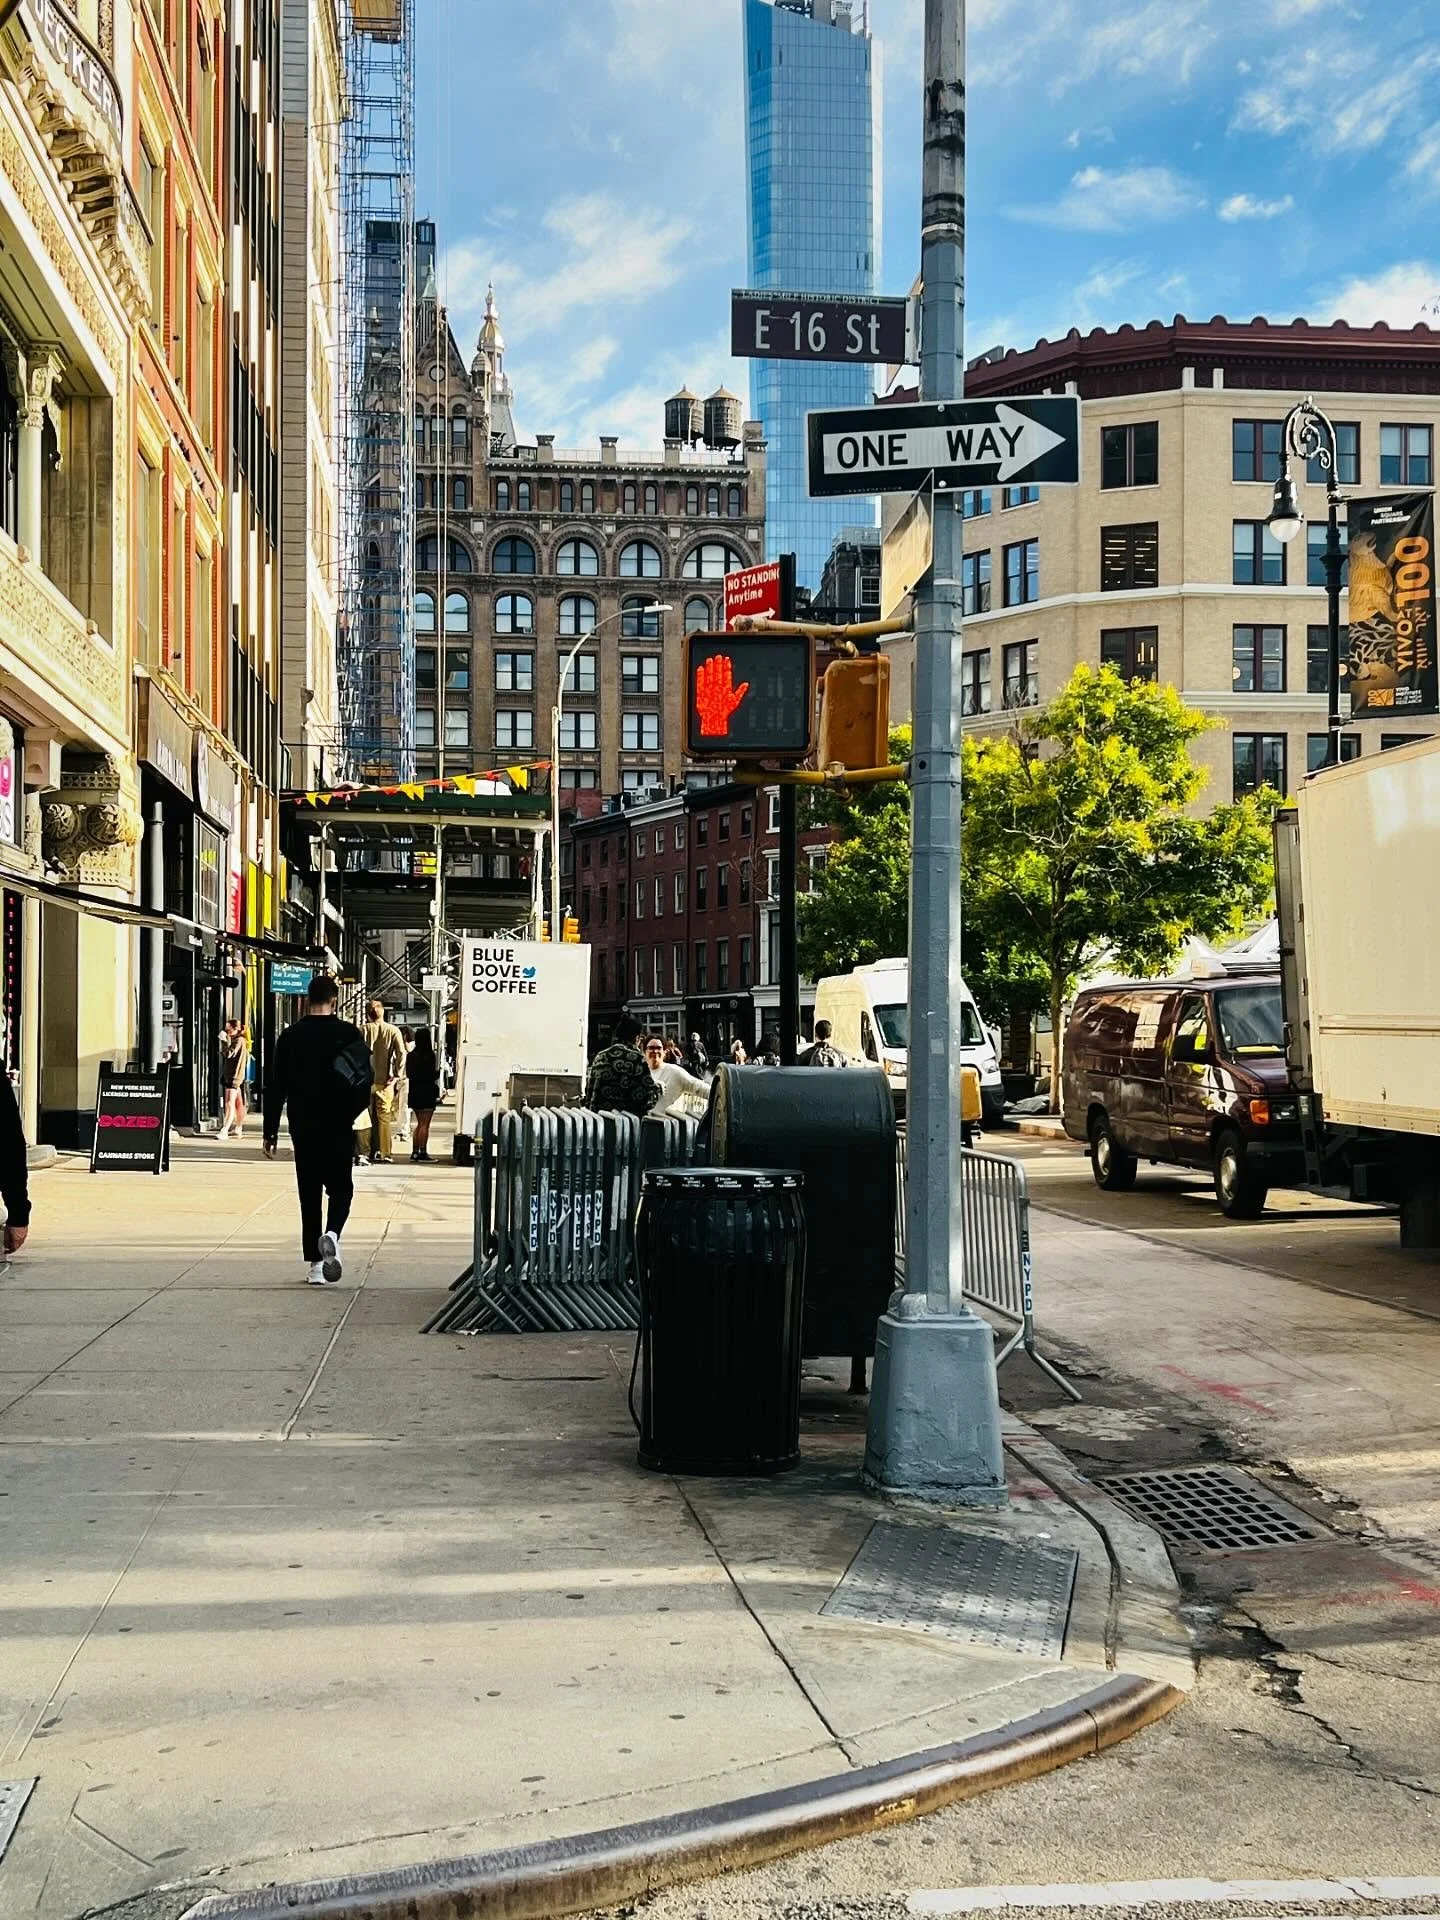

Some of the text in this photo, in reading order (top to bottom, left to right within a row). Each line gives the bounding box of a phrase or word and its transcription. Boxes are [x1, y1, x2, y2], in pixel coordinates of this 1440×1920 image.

[801, 293, 841, 304] HISTORIC
[842, 294, 881, 306] DISTRICT
[755, 309, 881, 355] E 16 St
[836, 425, 1025, 469] ONE WAY
[1395, 536, 1430, 607] 100
[727, 578, 740, 591] NO
[728, 588, 763, 606] Anytime
[1397, 619, 1413, 672] YIVO
[473, 947, 514, 962] BLUE
[472, 963, 521, 978] DOVE
[471, 979, 537, 995] COFFEE
[98, 1151, 156, 1160] CANNABIS STORE
[530, 1197, 538, 1248] NYPD
[1023, 1253, 1033, 1312] NYPD
